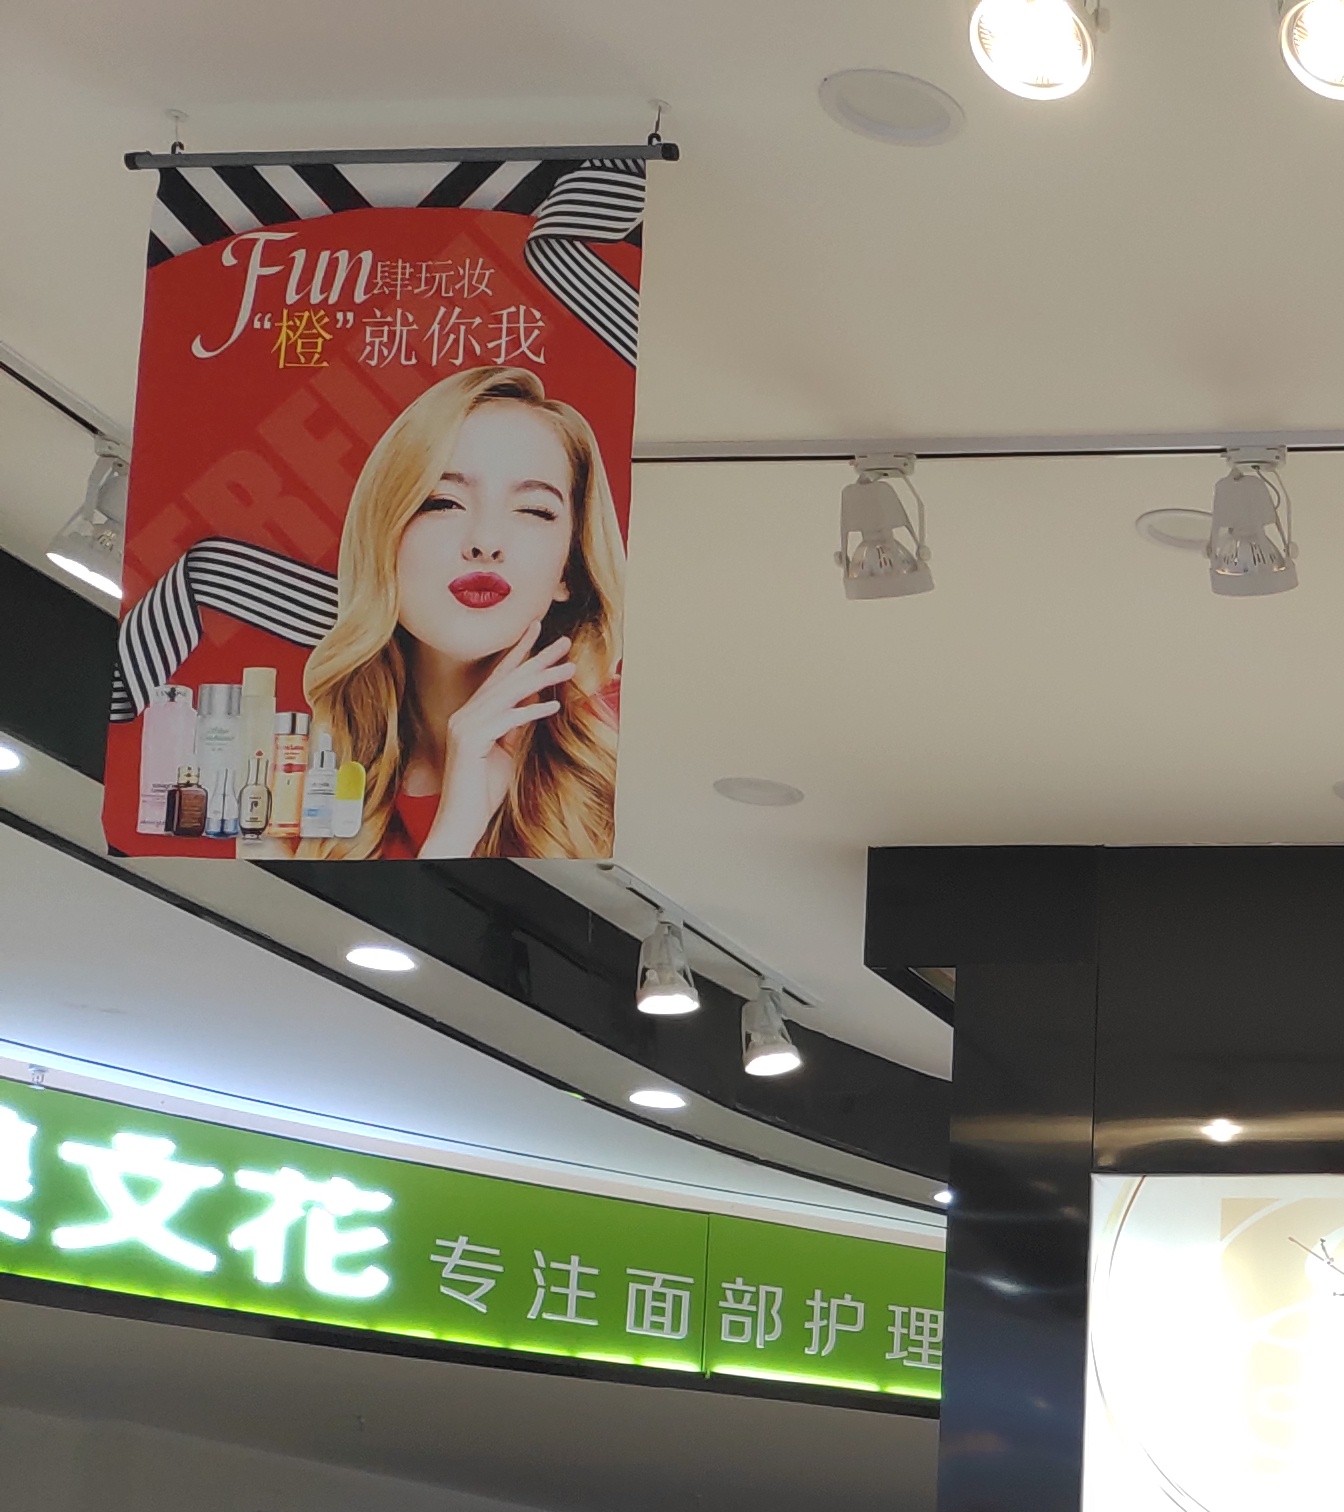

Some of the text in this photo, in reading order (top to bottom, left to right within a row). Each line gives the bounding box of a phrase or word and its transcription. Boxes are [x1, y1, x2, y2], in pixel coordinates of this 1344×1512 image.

[192, 231, 495, 358] Fun 肆玩妆
[428, 1234, 944, 1370] 专注面部护理
